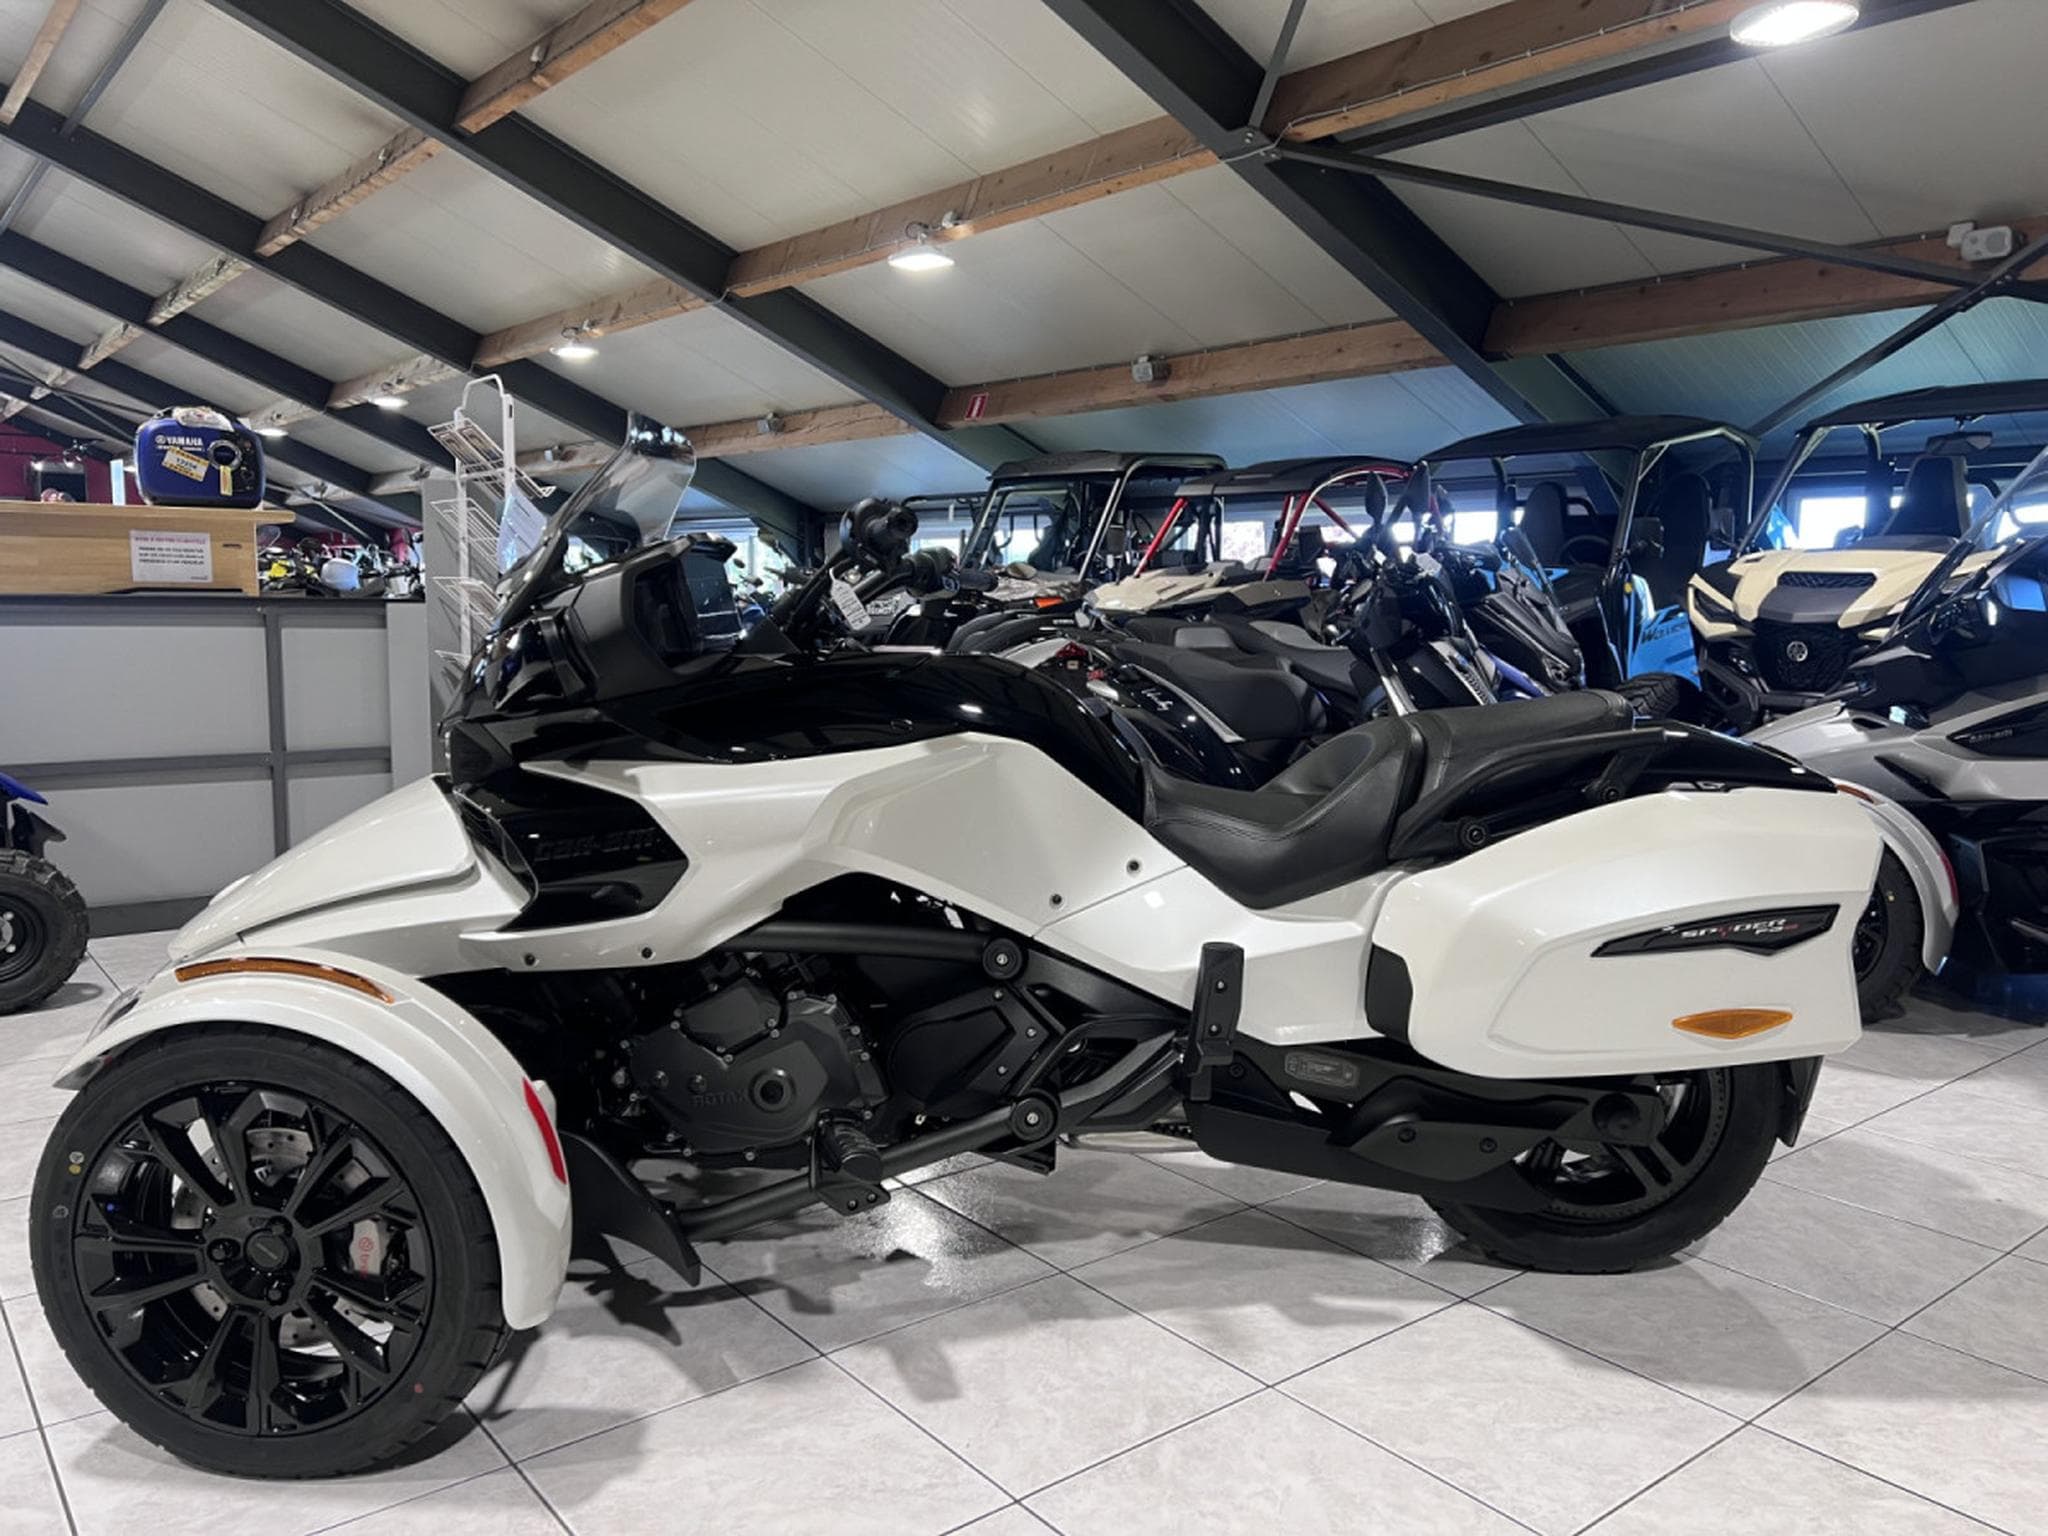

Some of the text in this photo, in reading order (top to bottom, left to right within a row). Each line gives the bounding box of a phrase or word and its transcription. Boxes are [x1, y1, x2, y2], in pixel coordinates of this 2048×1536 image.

[167, 435, 204, 446] YAMAHA
[1682, 919, 1786, 937] SPYDER
[690, 1088, 750, 1108] ROTAX
